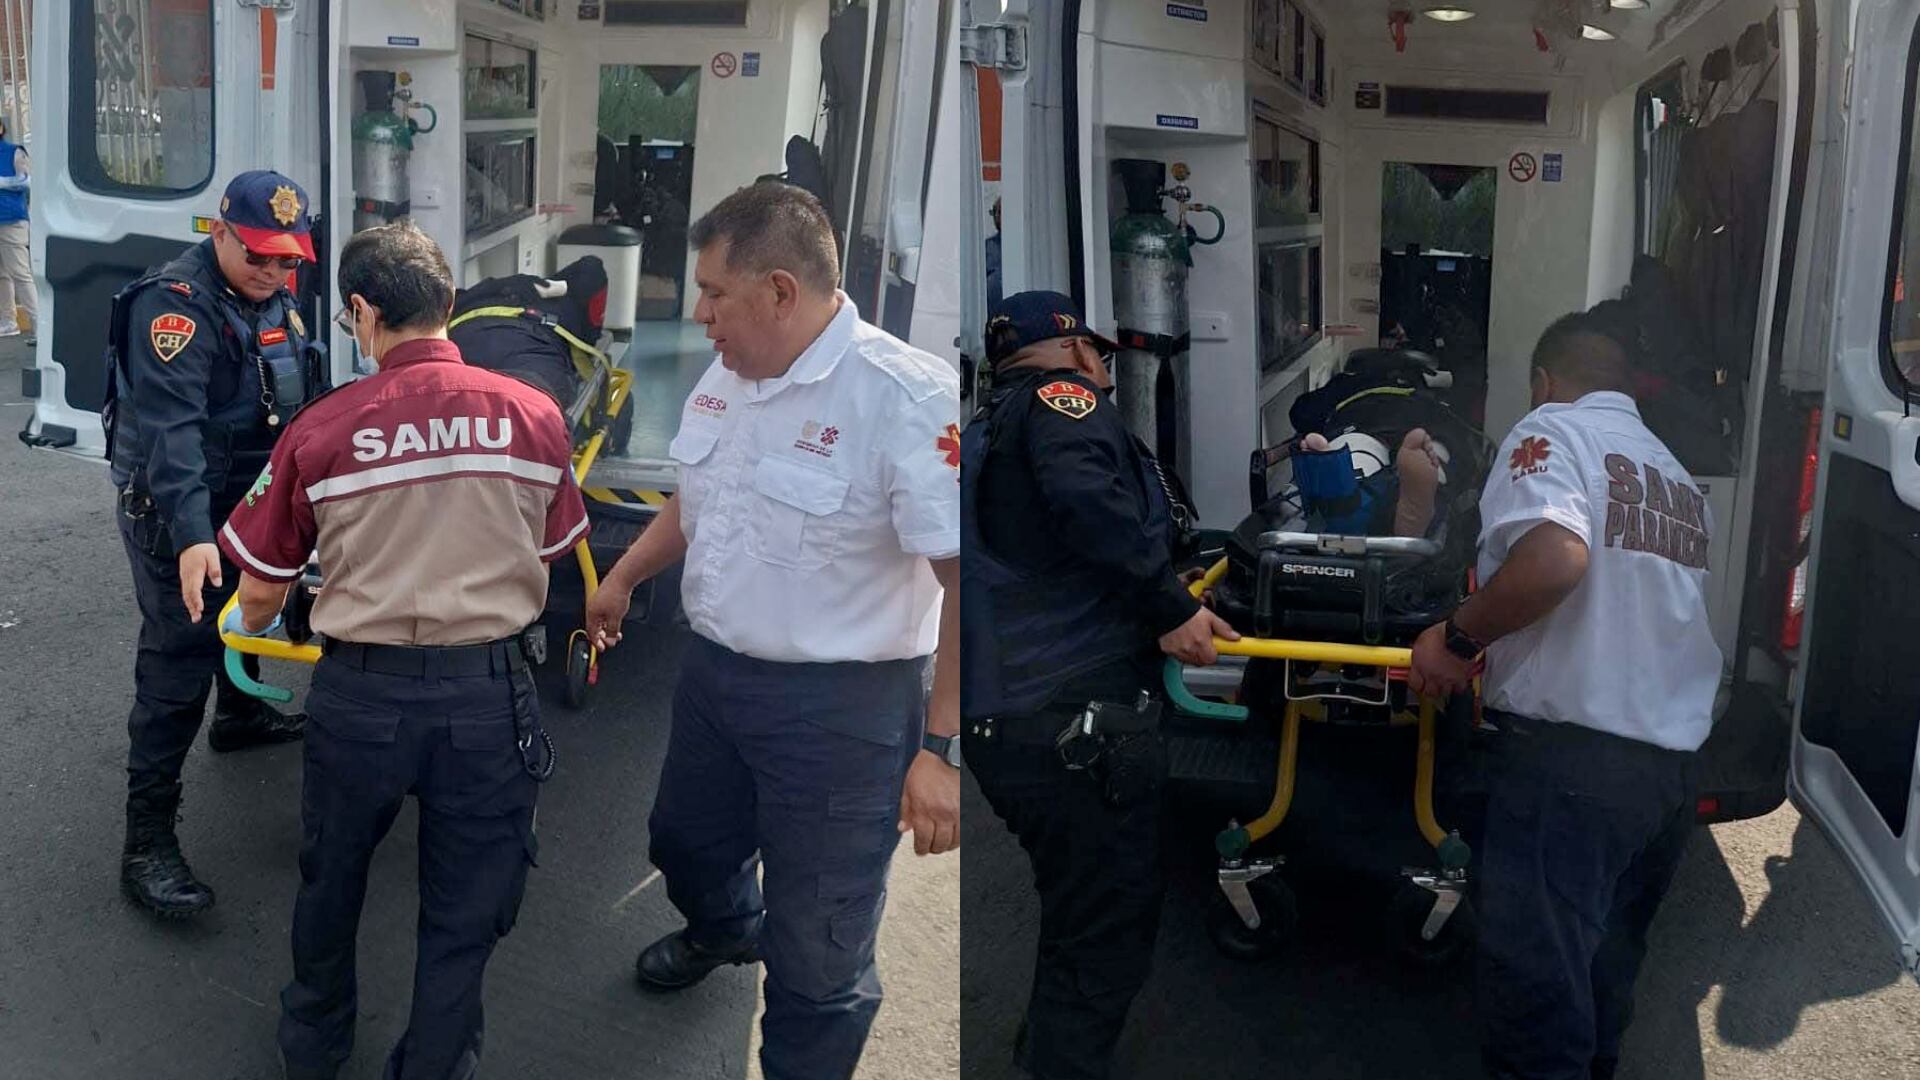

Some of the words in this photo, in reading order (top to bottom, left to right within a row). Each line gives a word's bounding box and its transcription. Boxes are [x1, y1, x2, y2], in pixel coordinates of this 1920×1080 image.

[157, 333, 182, 348] CH
[692, 393, 727, 412] EDESA
[1053, 397, 1088, 410] CH
[352, 416, 512, 462] SAMU
[1282, 563, 1355, 578] SPENCER
